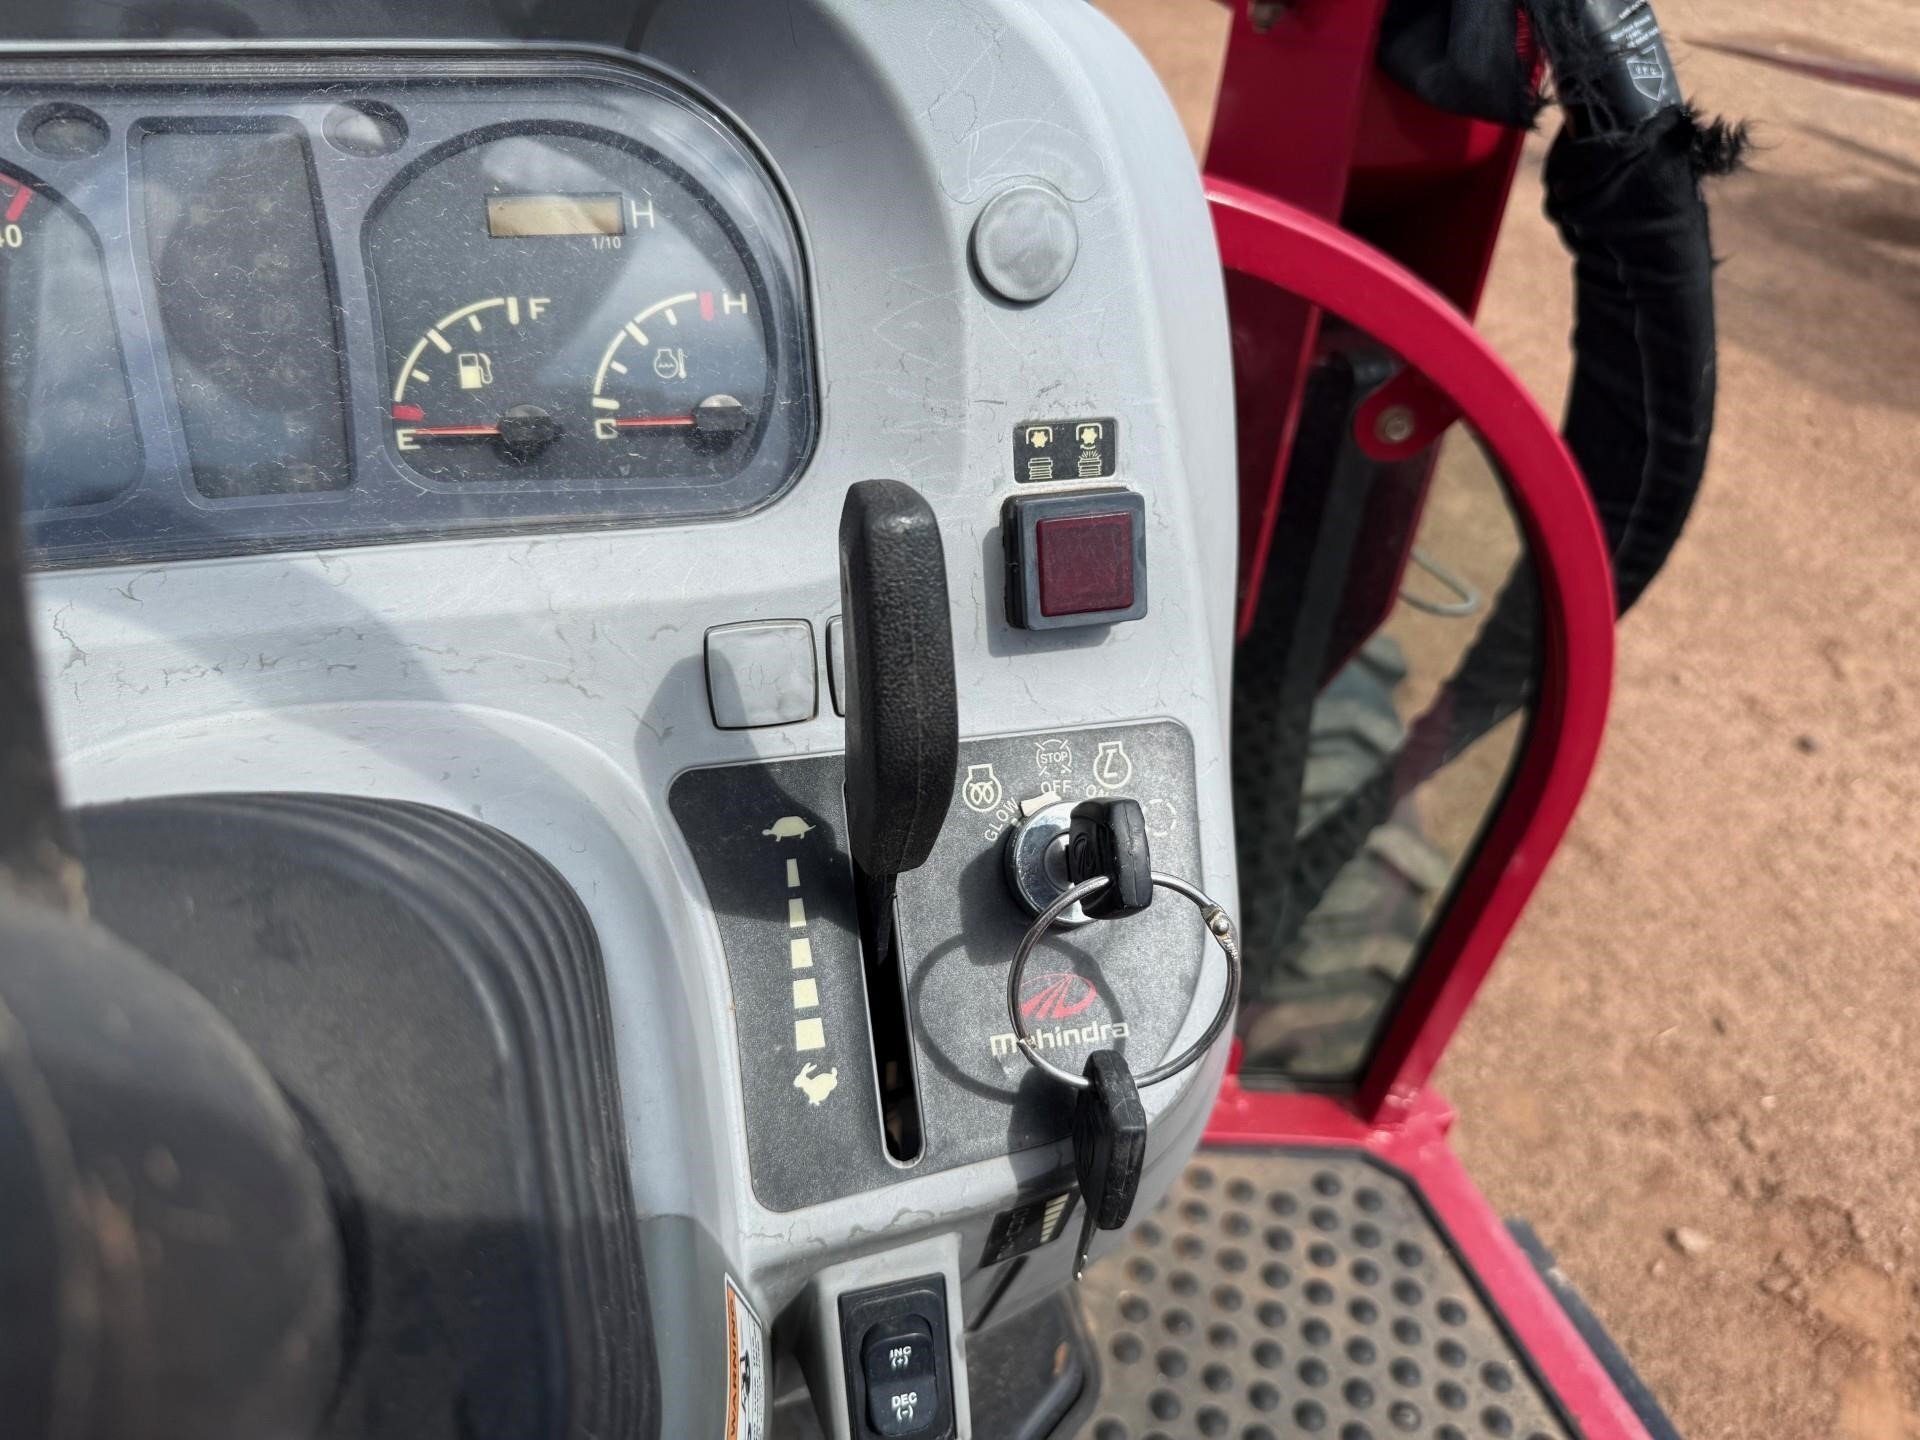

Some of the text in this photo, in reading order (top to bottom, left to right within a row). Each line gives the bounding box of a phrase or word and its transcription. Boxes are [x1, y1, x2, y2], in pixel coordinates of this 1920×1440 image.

[631, 199, 654, 228] H
[0, 224, 23, 248] 0
[592, 237, 621, 249] 1/10
[529, 297, 551, 320] F
[723, 292, 747, 315] H
[396, 428, 421, 450] E
[1040, 751, 1068, 764] STOP
[1041, 779, 1072, 794] OFF
[984, 797, 1019, 841] GLOW
[889, 1345, 912, 1358] INC
[891, 1391, 918, 1409] DEC
